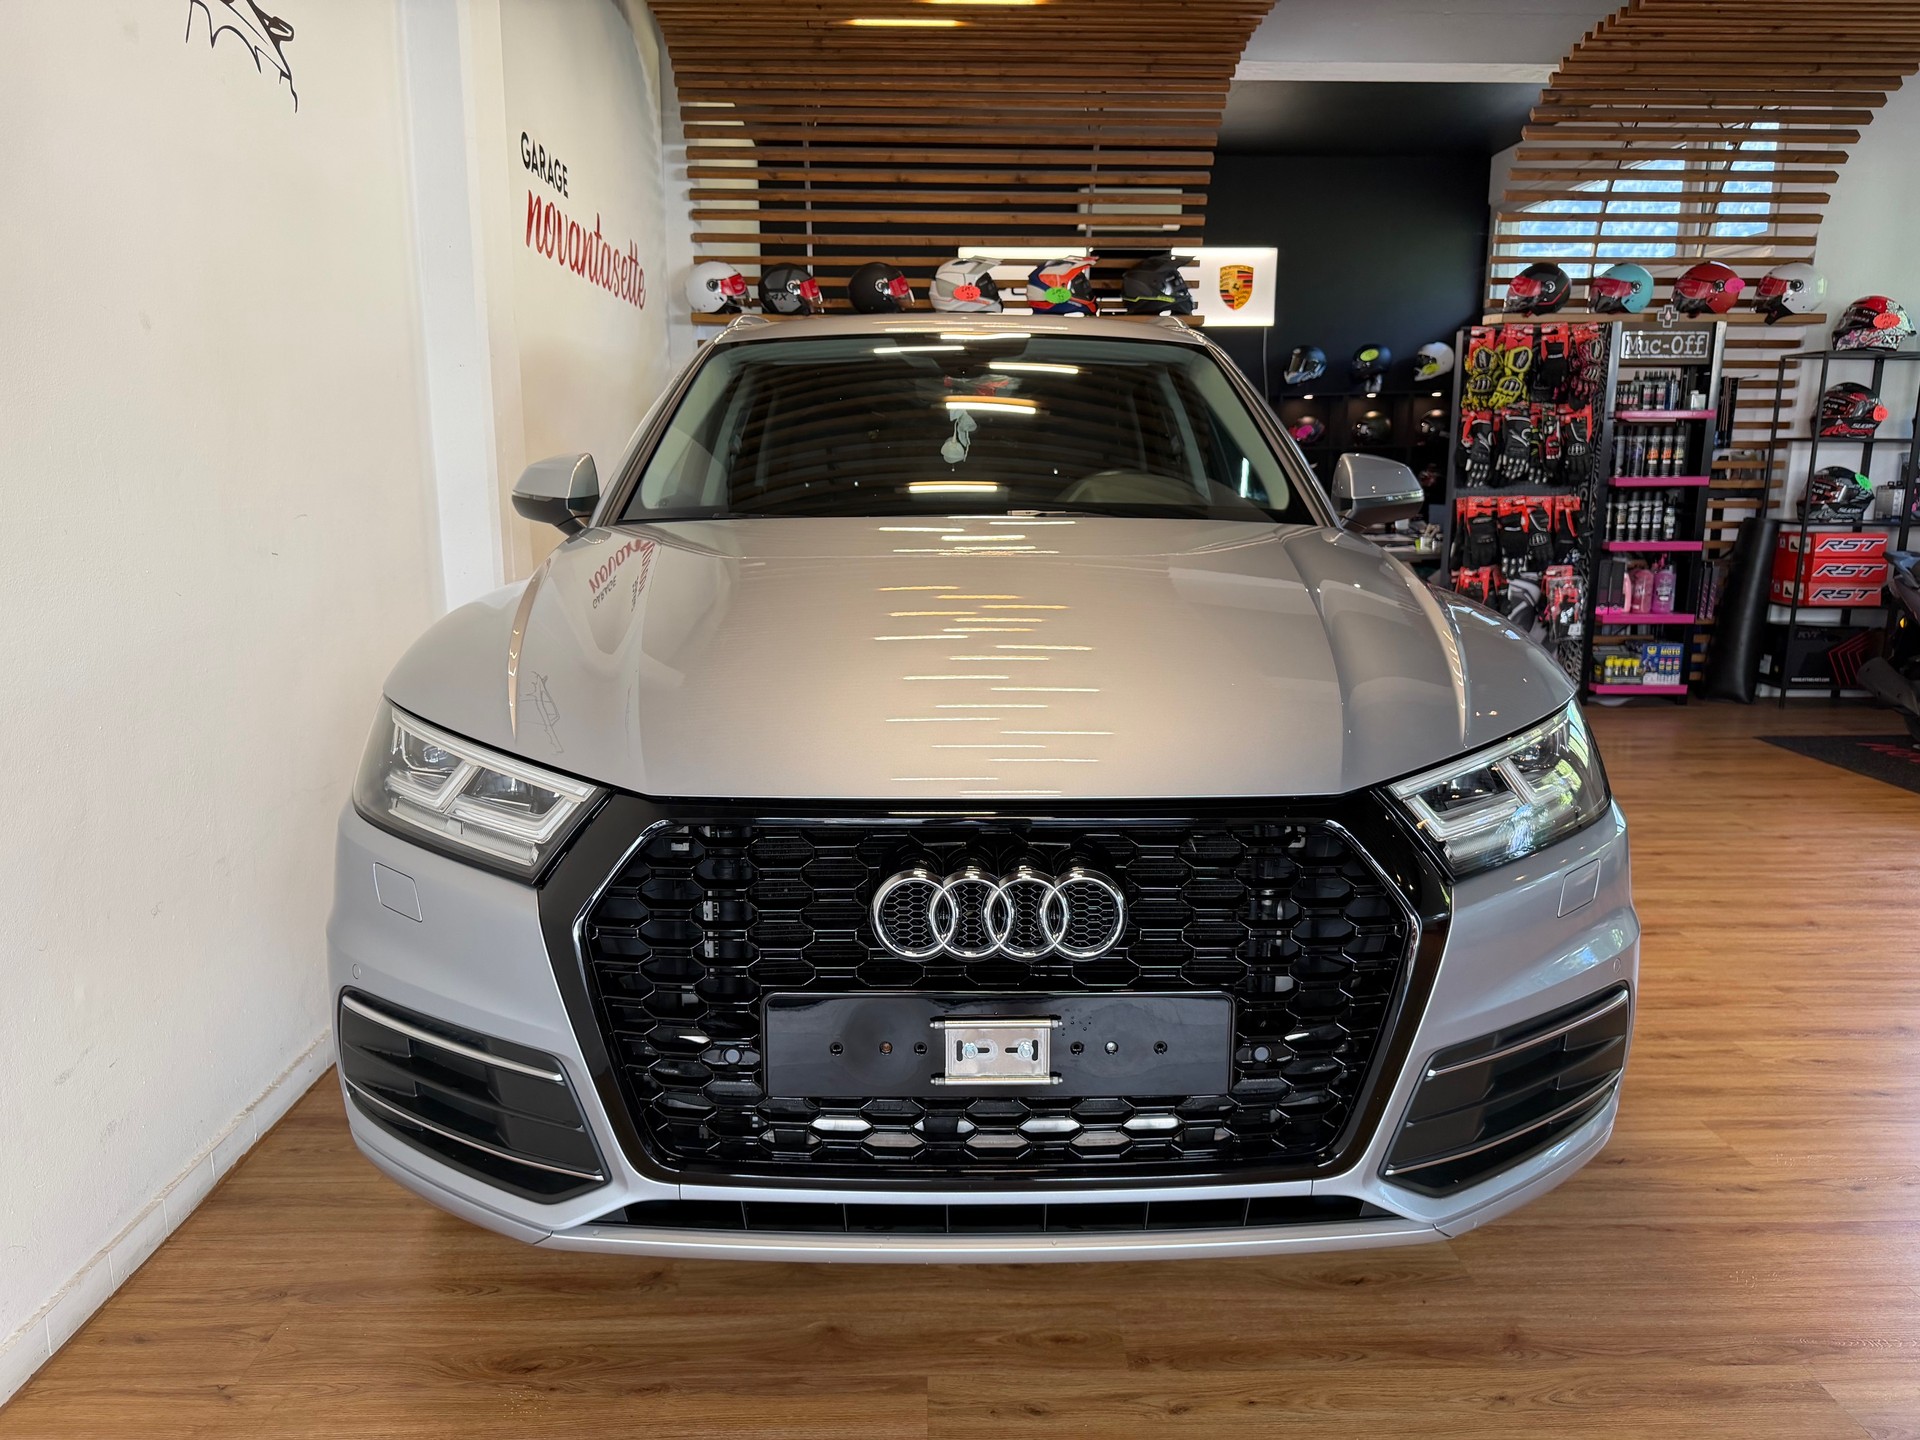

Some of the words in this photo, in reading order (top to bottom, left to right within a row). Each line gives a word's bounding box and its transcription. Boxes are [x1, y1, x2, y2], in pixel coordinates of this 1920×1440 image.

[521, 131, 569, 199] GARAGE
[526, 189, 646, 310] novantasette
[1625, 335, 1706, 355] Muc-Off
[1815, 538, 1887, 552] RST
[1812, 563, 1887, 577] RST
[1809, 587, 1881, 601] RST
